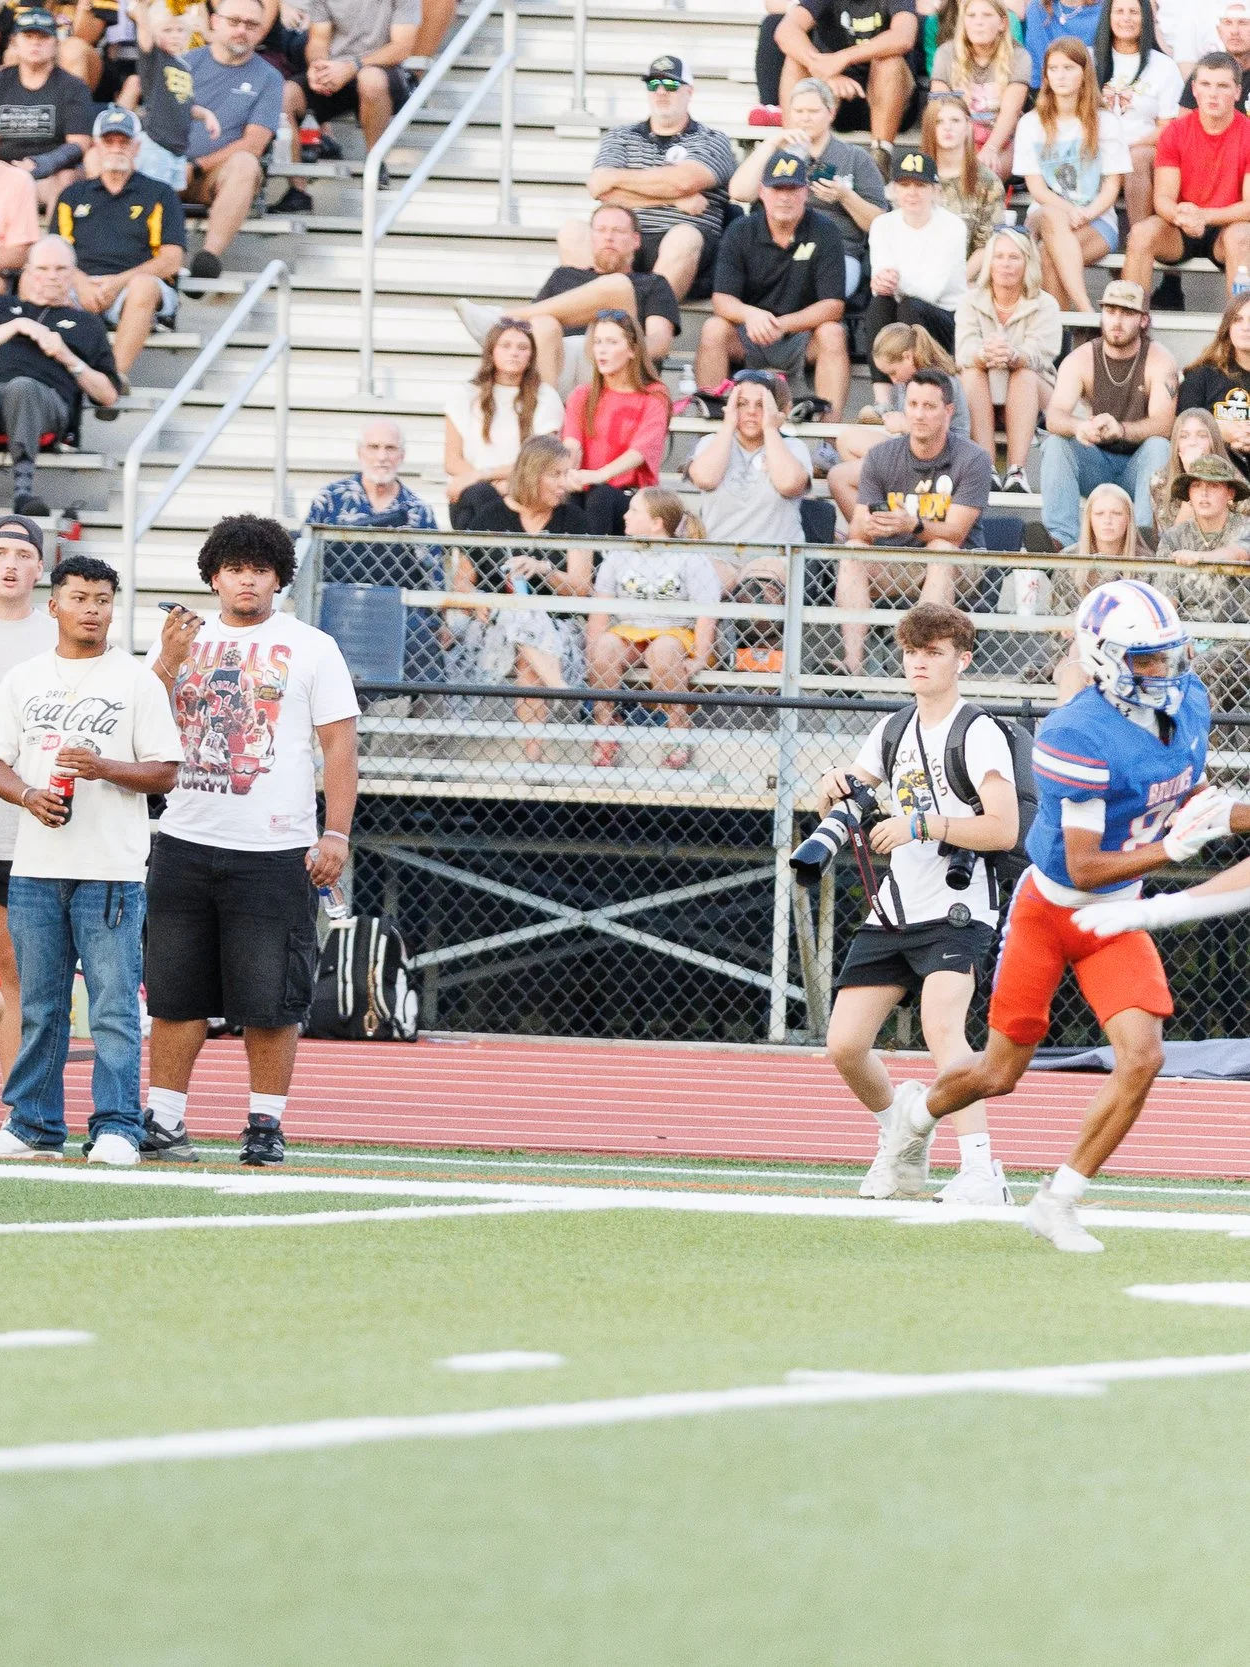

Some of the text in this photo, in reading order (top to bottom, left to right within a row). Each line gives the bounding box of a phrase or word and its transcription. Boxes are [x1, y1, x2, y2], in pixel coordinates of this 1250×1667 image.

[771, 157, 799, 178] N
[900, 153, 925, 174] 41
[22, 695, 127, 736] Coca-Cola
[177, 765, 230, 796] ORM
